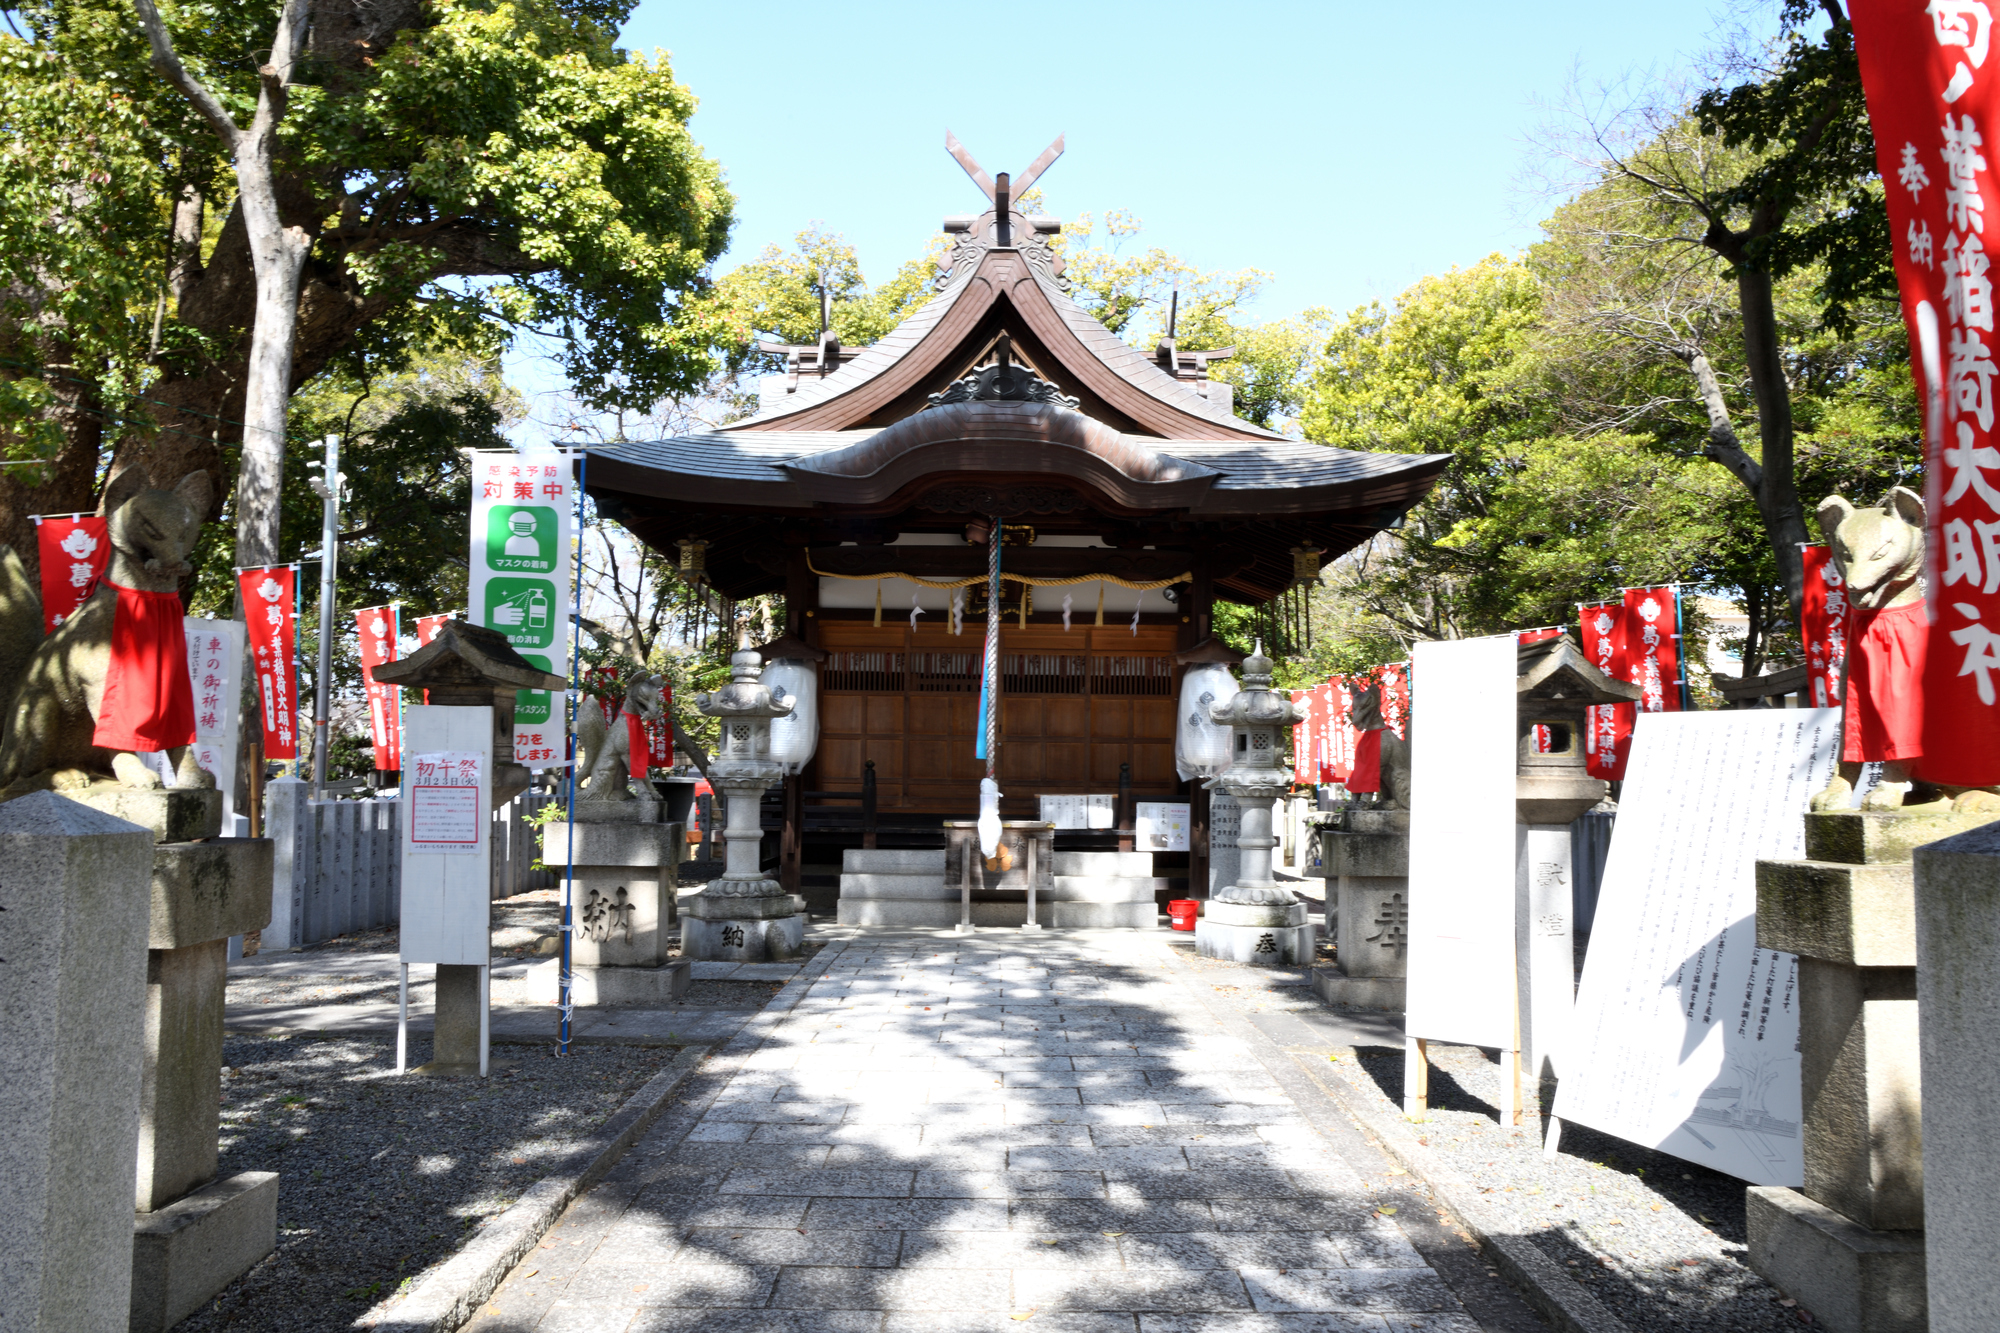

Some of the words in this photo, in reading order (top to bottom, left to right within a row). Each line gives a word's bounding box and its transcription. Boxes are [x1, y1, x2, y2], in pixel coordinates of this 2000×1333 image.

[1898, 141, 1933, 272] 奉納
[488, 465, 557, 477] 感染予防
[482, 480, 563, 501] 対策中
[495, 559, 549, 570] マスクの着用
[199, 636, 223, 730] 車の御祈祷
[265, 603, 292, 748] 葛ノ葉稲荷大明神
[516, 748, 558, 761] します。
[415, 758, 478, 778] 初午祭
[415, 777, 478, 786] 3月23日(火)
[580, 886, 636, 945] 納
[1366, 893, 1409, 959] 奉
[721, 925, 745, 948] 納
[1255, 932, 1278, 955] 奉
